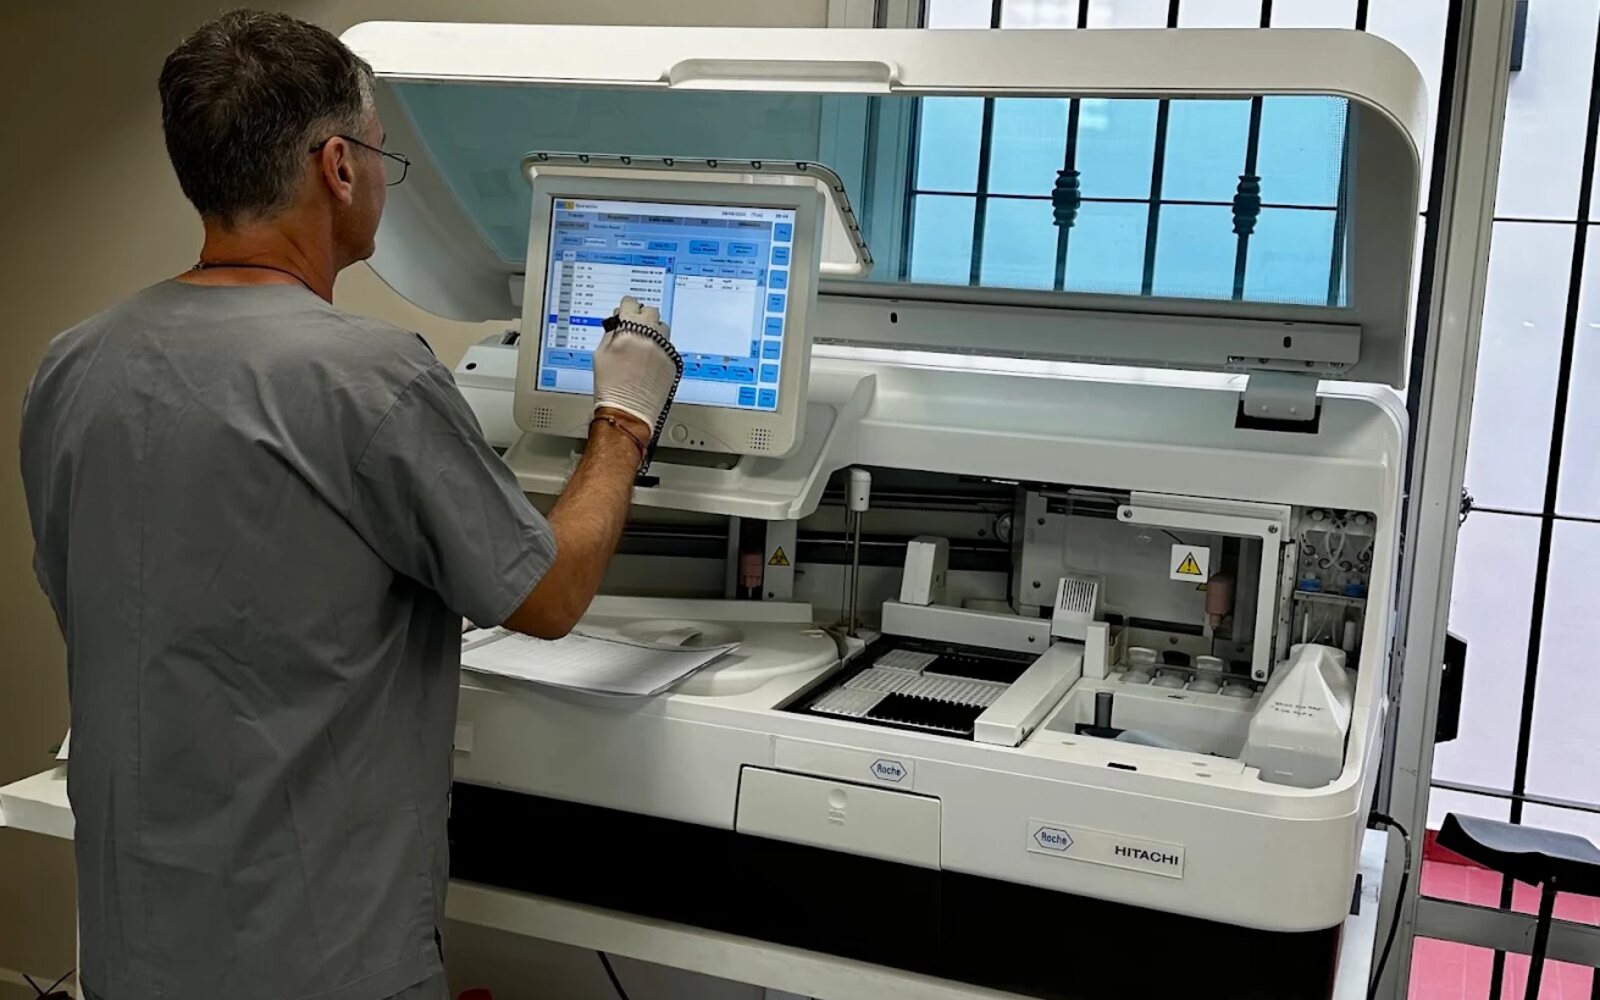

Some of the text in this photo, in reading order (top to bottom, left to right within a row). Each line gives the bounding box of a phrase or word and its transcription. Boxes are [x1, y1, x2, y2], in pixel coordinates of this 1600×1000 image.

[876, 763, 902, 777] Roche
[1041, 831, 1179, 866] Roche HITACHI
